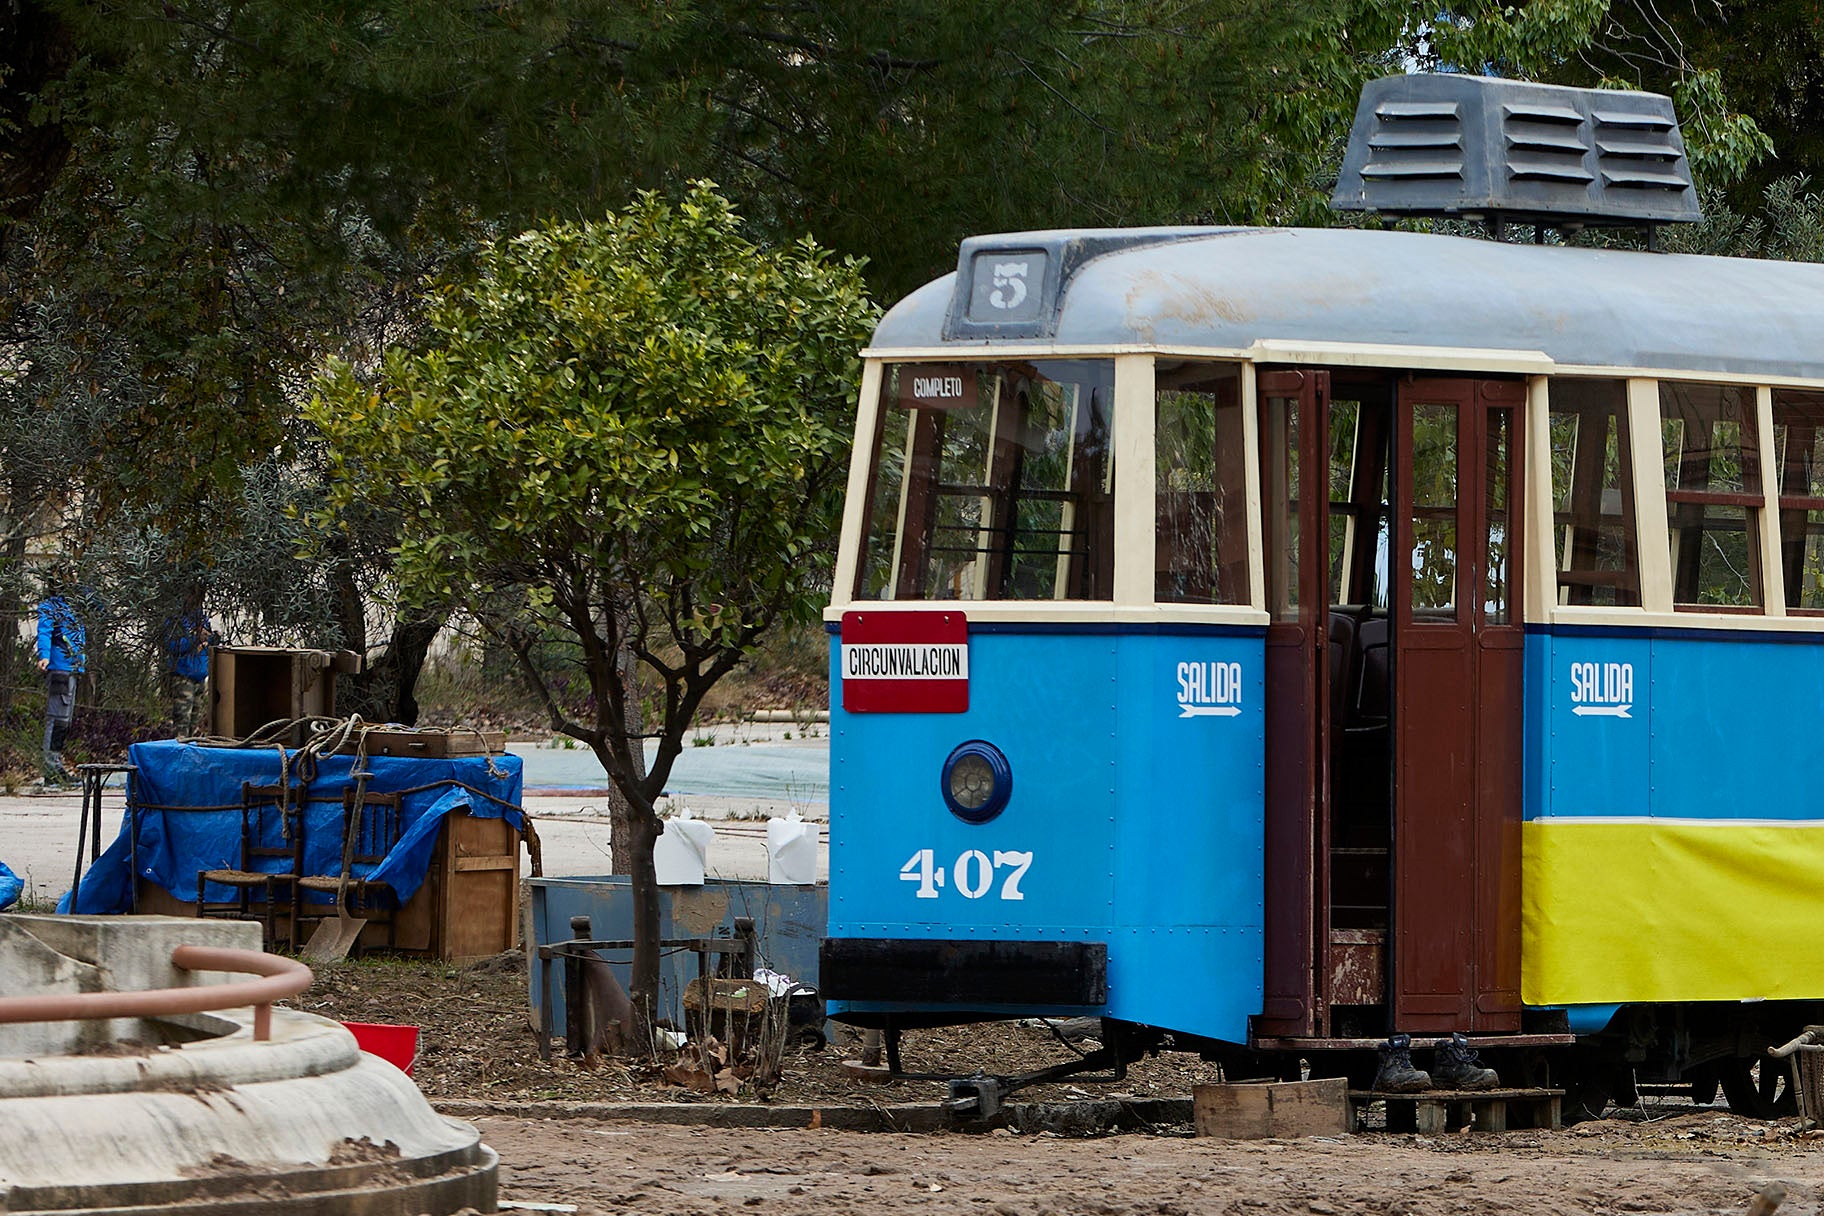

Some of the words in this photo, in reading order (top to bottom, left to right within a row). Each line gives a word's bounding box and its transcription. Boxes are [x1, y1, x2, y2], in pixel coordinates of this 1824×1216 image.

[990, 262, 1028, 309] 5
[913, 377, 962, 398] COMPLETO
[849, 647, 960, 676] CIRCUNVALACION
[1176, 661, 1242, 704] SALIDA
[1570, 662, 1633, 703] SALIDA
[899, 848, 1034, 901] 407
